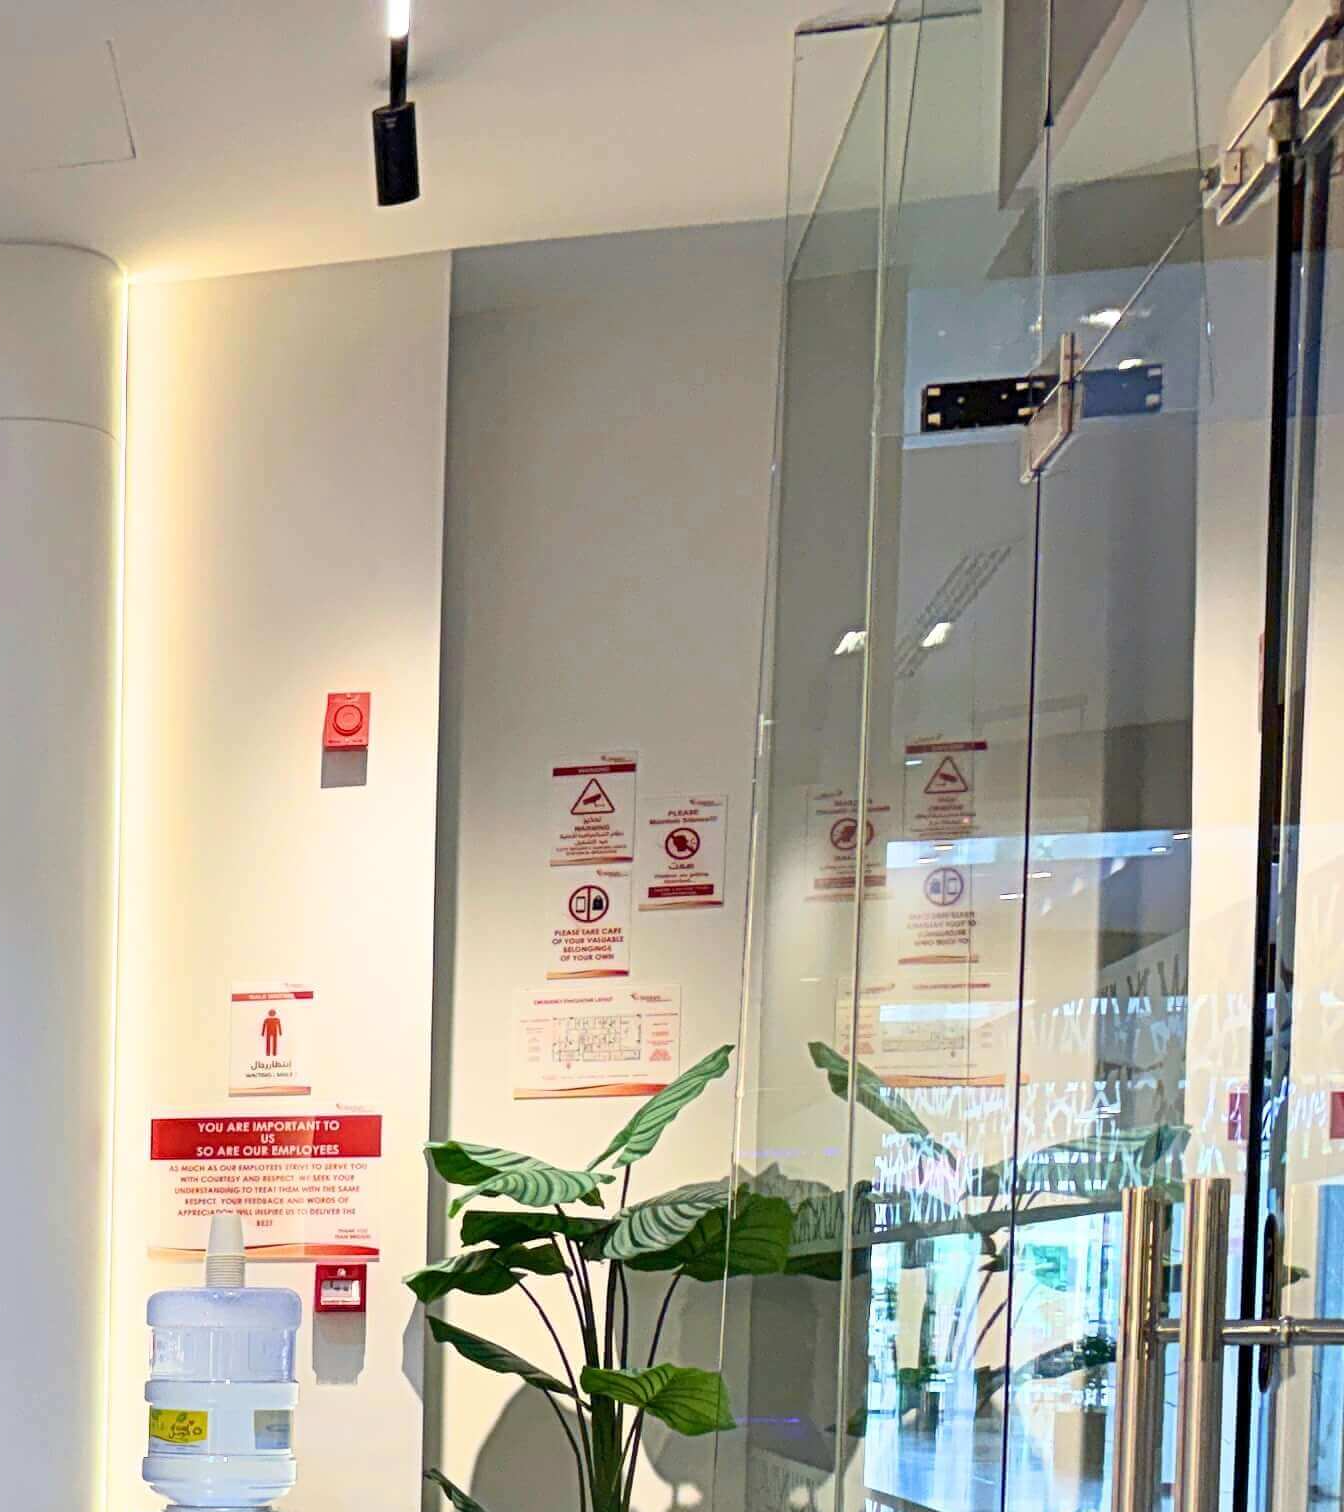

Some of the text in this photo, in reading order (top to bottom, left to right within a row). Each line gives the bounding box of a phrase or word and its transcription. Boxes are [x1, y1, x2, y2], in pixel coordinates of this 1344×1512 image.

[554, 929, 580, 937] PLEASE
[197, 1120, 341, 1133] YOU ARE IMPORTANT TO
[260, 1133, 276, 1144] US
[196, 1144, 341, 1157] SO ARE OUR EMPLOYEES
[181, 1164, 206, 1172] MUCH
[238, 1163, 283, 1171] EMPLOYEES
[200, 1175, 240, 1183] COURTESY
[174, 1187, 240, 1195] UNDERSTANDING
[254, 1186, 276, 1194] TREAT
[244, 1197, 284, 1205] FEEDBACK
